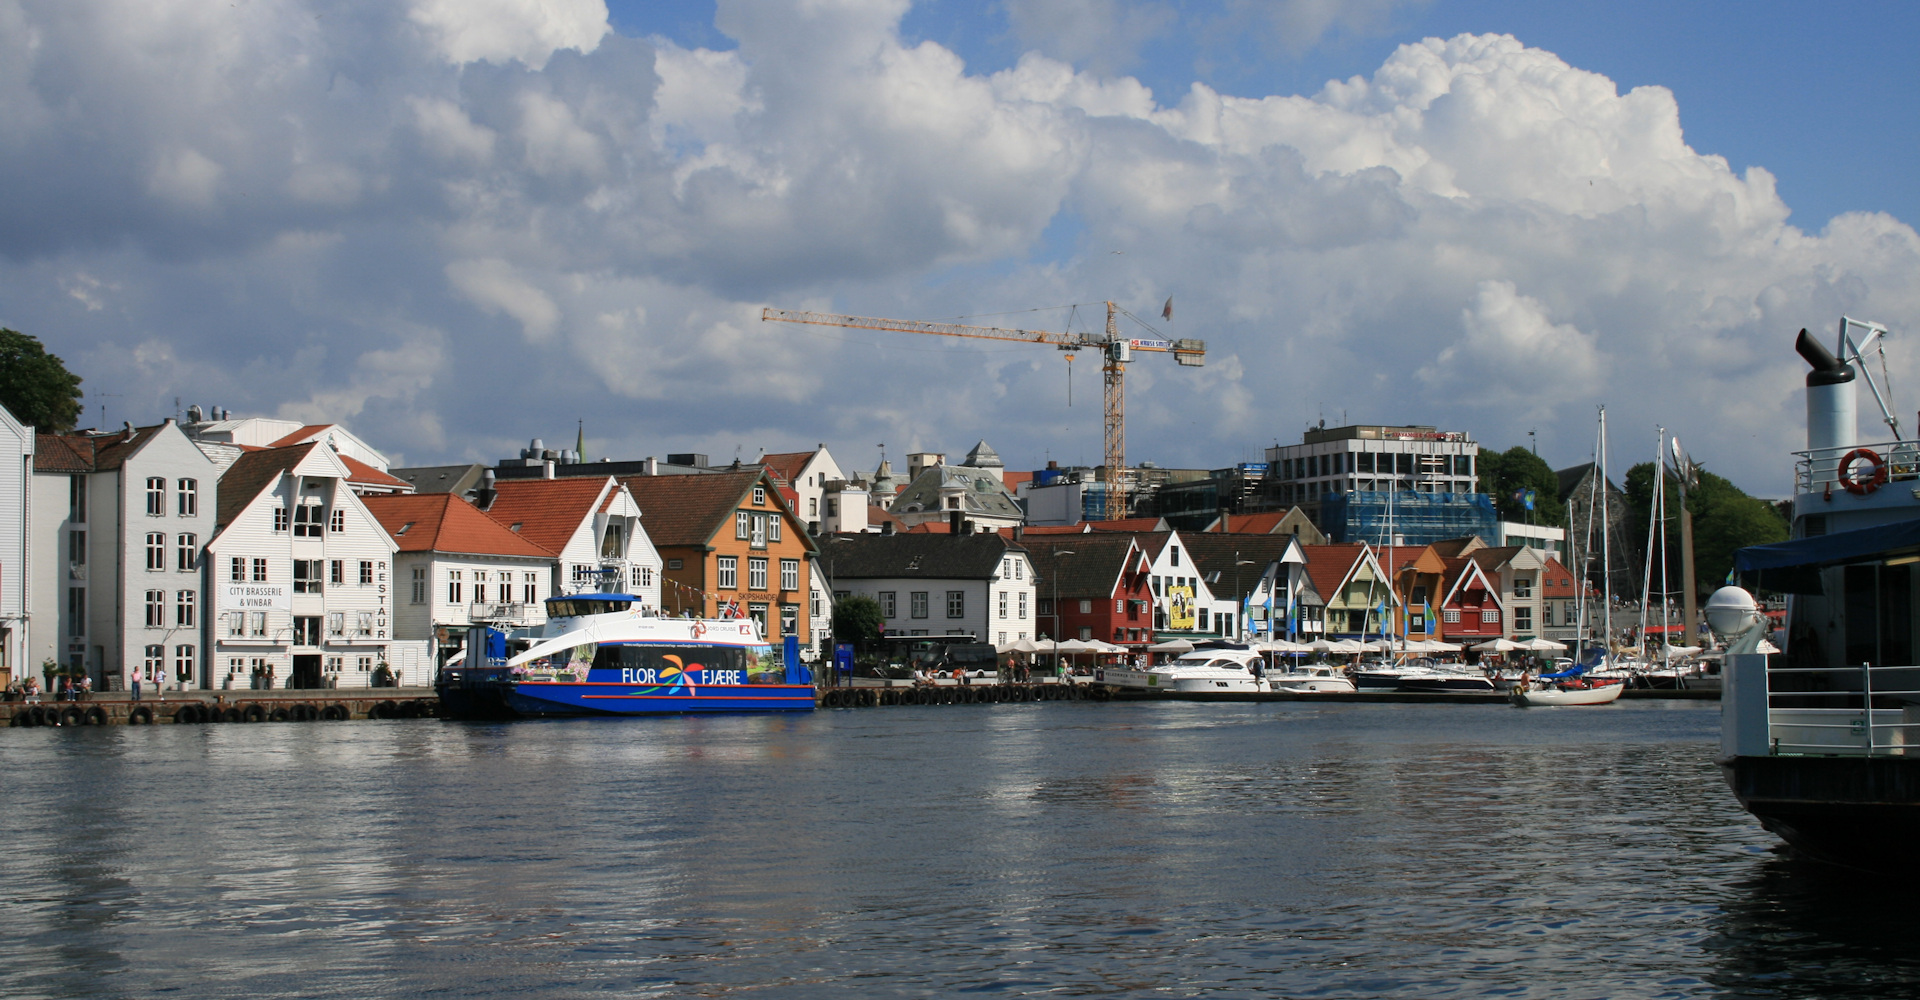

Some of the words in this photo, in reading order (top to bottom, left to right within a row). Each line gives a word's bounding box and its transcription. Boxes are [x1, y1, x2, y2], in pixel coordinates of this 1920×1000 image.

[229, 586, 245, 596] CITY
[246, 587, 282, 597] BRASSERIE
[239, 598, 245, 607] &
[246, 598, 273, 607] VINBAR
[377, 561, 386, 667] RESTAURAN
[621, 667, 657, 684] FLOR
[701, 669, 741, 685] FJÆRE
